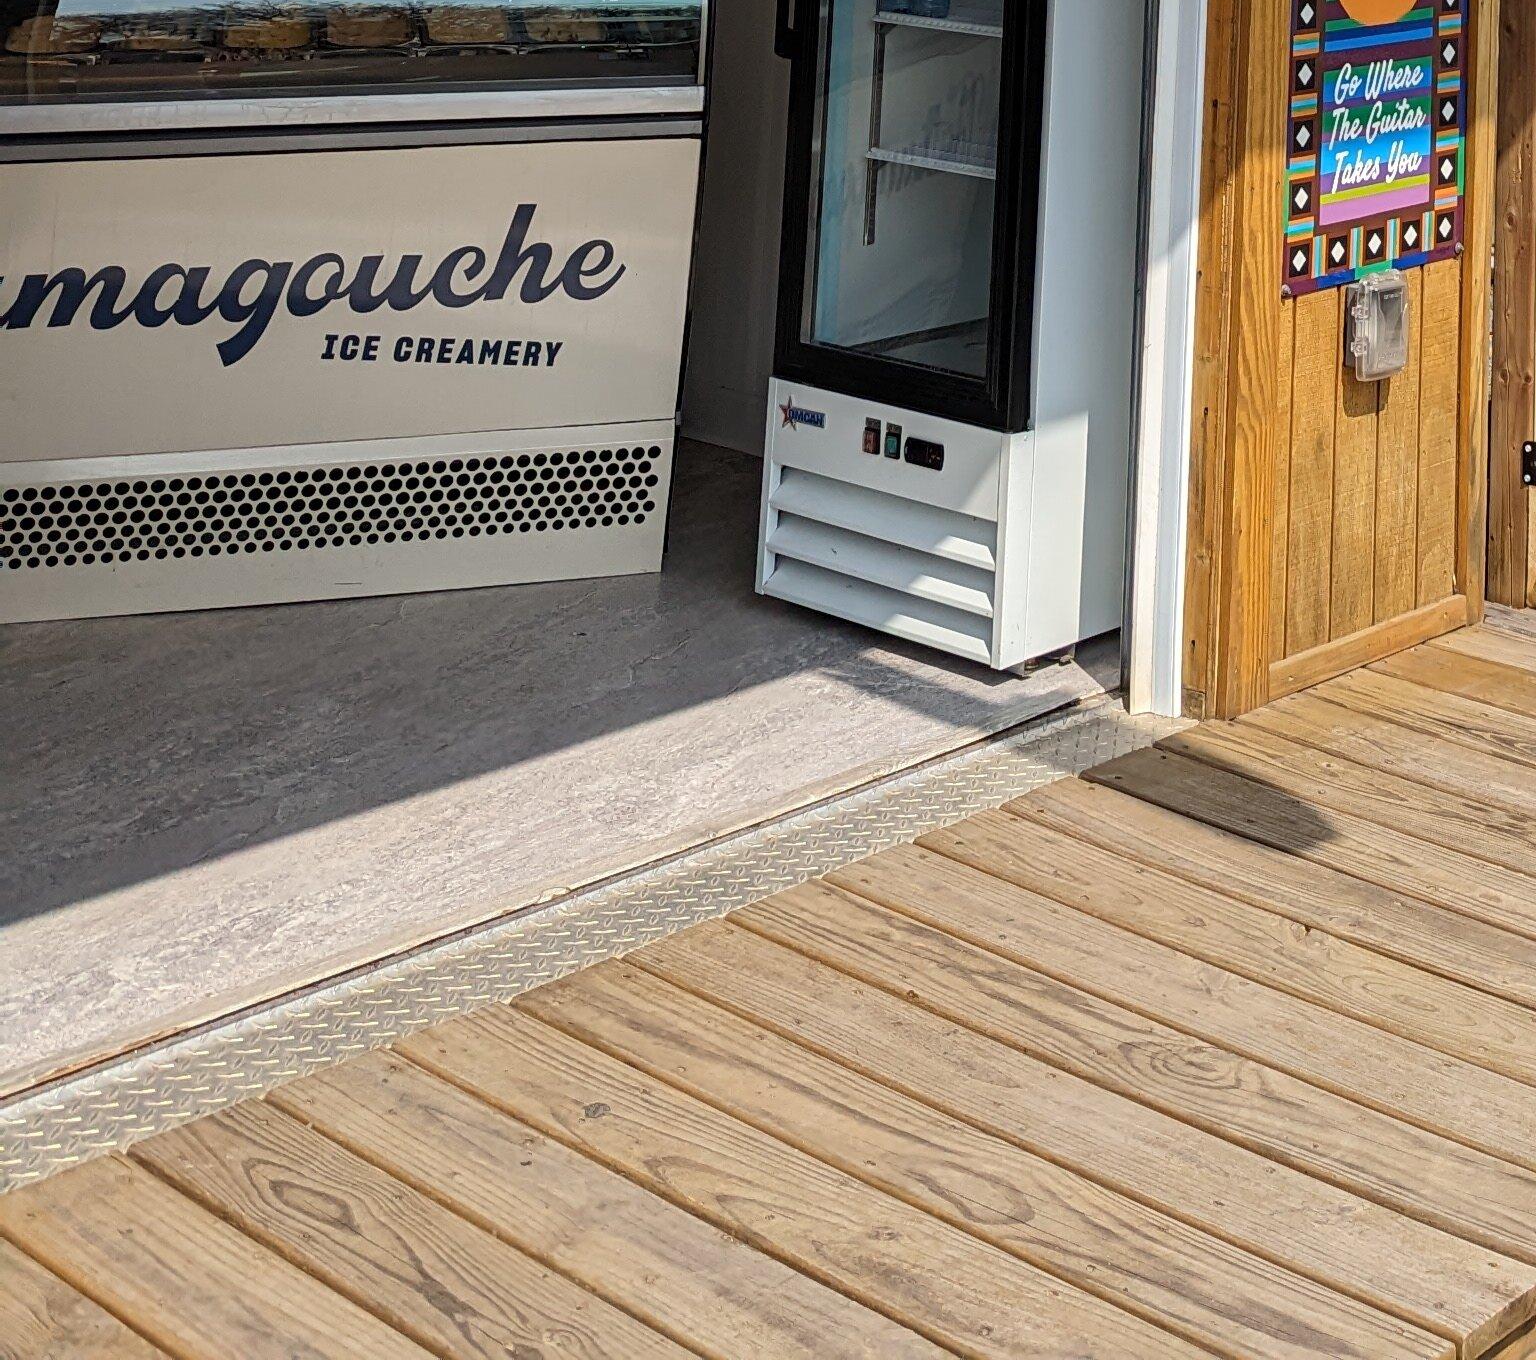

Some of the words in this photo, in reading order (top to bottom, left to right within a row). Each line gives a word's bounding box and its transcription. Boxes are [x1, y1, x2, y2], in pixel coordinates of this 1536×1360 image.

[1334, 62, 1362, 105] Go
[1364, 58, 1424, 102] Where
[1329, 105, 1364, 151] The
[1365, 97, 1427, 145] Guitar
[1331, 149, 1381, 195] Takes
[1386, 139, 1423, 185] You
[321, 333, 382, 362] ICE
[393, 334, 564, 368] CREAMERY
